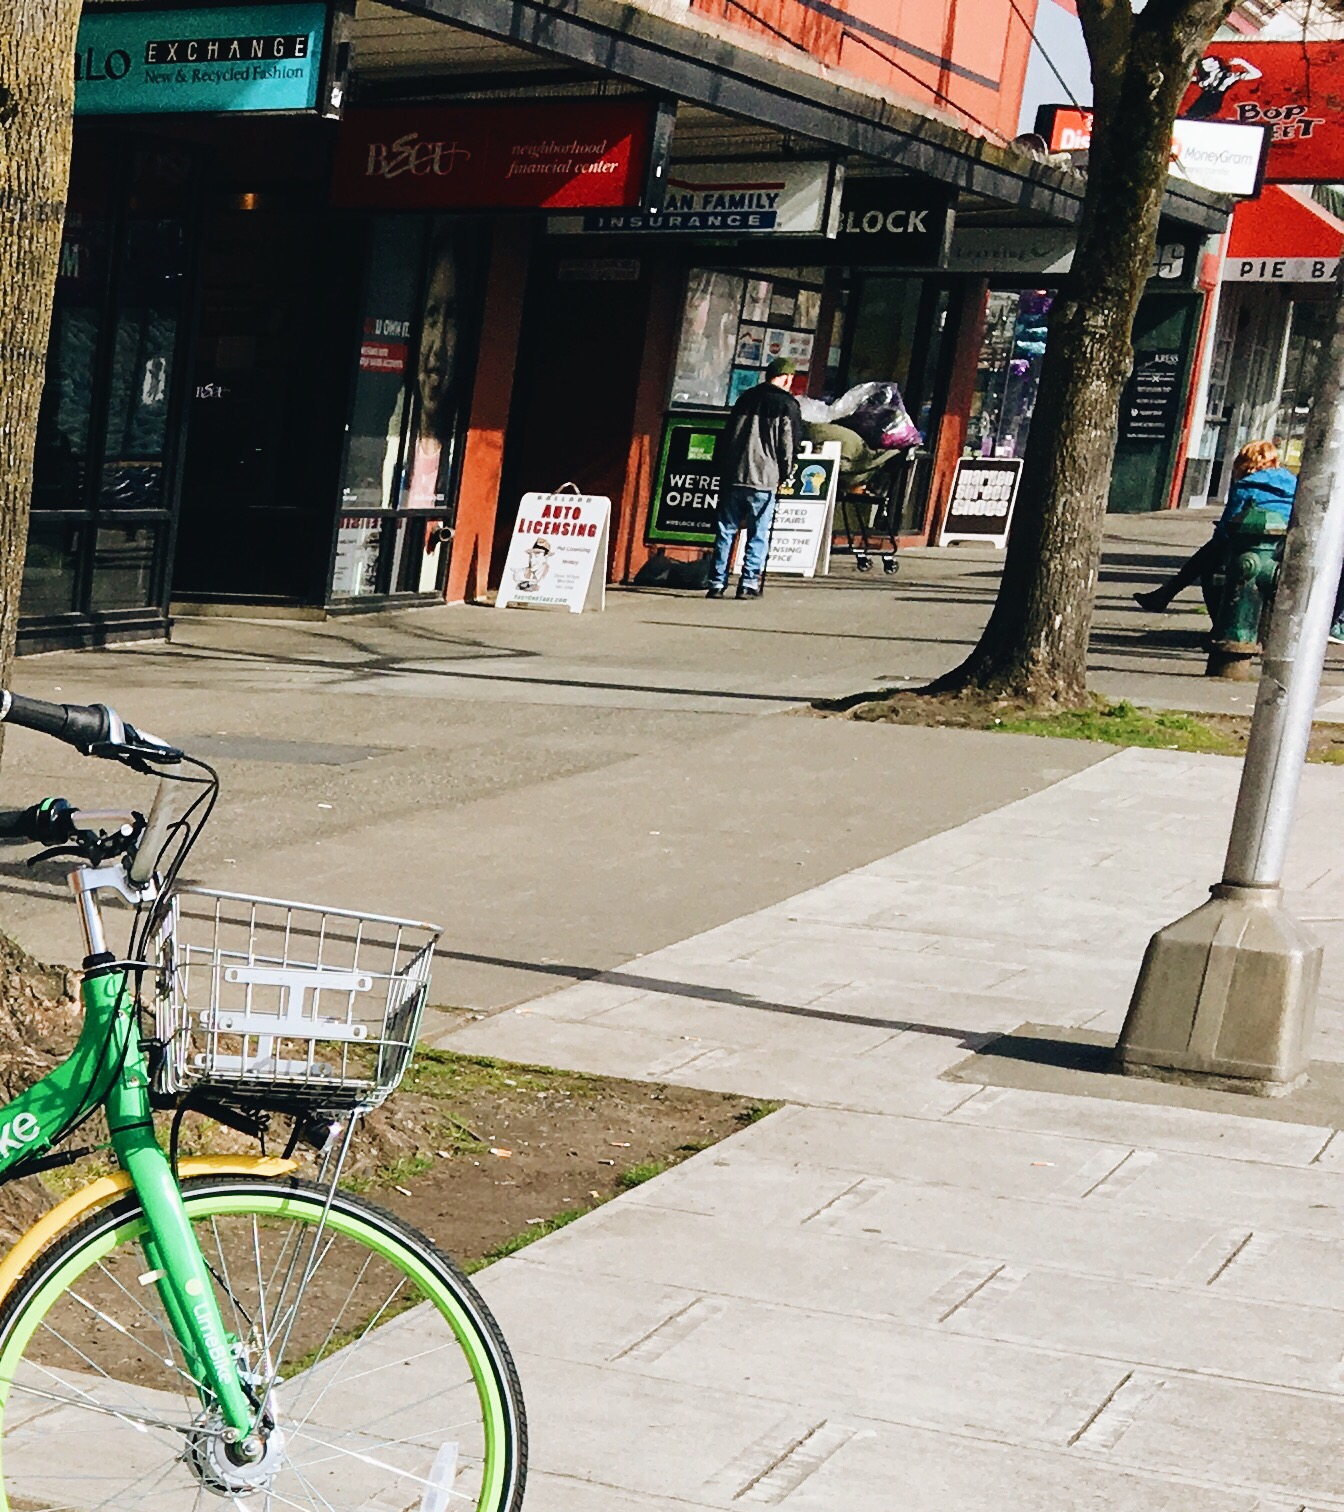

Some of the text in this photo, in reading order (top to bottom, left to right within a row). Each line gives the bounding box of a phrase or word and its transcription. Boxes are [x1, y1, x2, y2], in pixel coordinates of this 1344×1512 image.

[148, 37, 305, 63] EXCHANGE
[145, 65, 303, 85] New & Recycled Fashion
[1269, 117, 1326, 142] EET
[1060, 128, 1091, 150] Dis
[512, 140, 609, 158] neighborhood
[1184, 147, 1253, 165] MoneyGram
[505, 159, 619, 179] financial center
[665, 192, 780, 211] AN FAMILY
[598, 214, 762, 228] INSURANCE
[1240, 260, 1286, 278] PIE
[669, 474, 721, 491] WE'RE
[666, 491, 720, 509] OPEN
[541, 504, 582, 520] AUTO
[518, 518, 598, 537] LICENSING
[792, 538, 810, 547] THE
[193, 1301, 232, 1385] LimeBike
